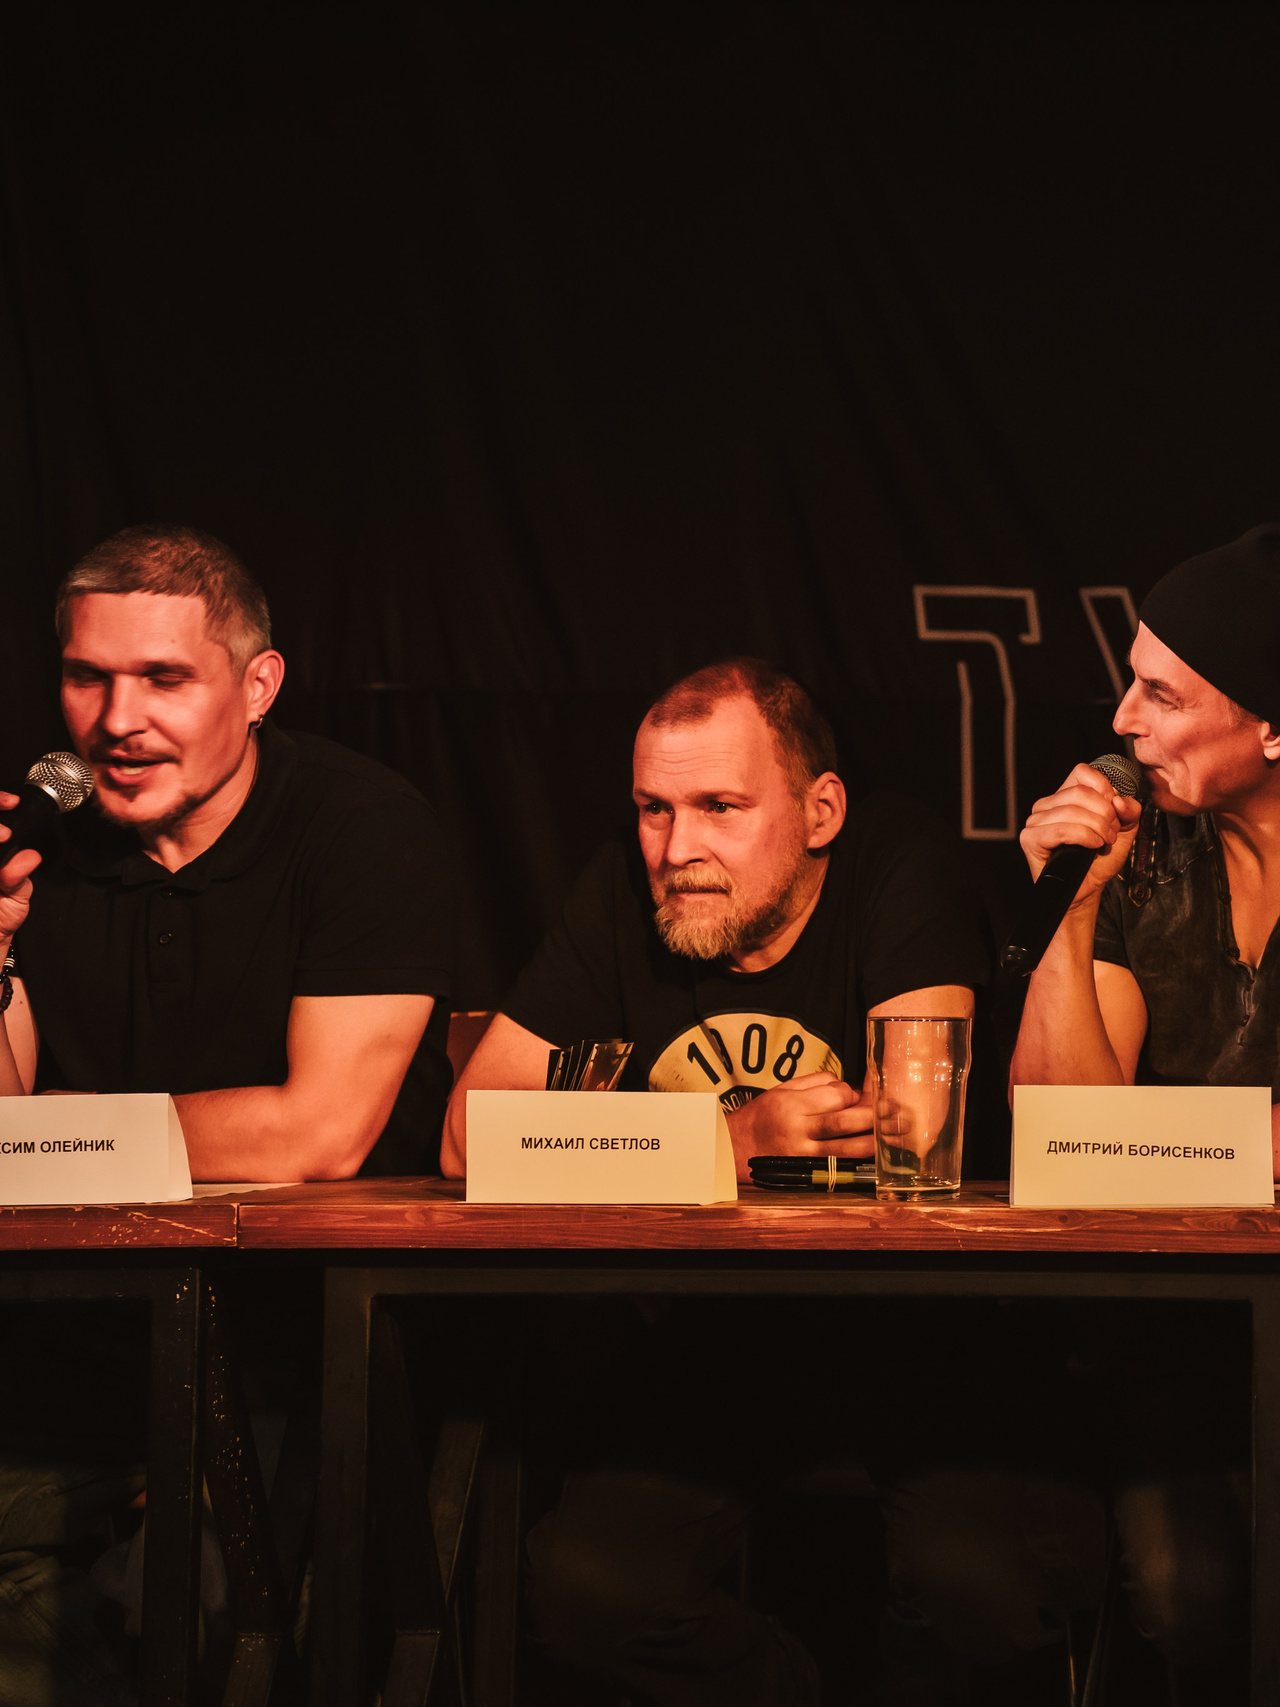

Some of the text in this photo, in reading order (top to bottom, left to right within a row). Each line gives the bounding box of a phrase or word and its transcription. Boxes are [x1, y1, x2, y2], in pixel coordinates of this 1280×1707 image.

[39, 1137, 115, 1153] ОЛЕЙНИК
[521, 1137, 661, 1151] МИХАИЛ СВЕТЛОВ
[1046, 1140, 1235, 1160] ДМИТРИЙ БОРИСЕНКОВ
